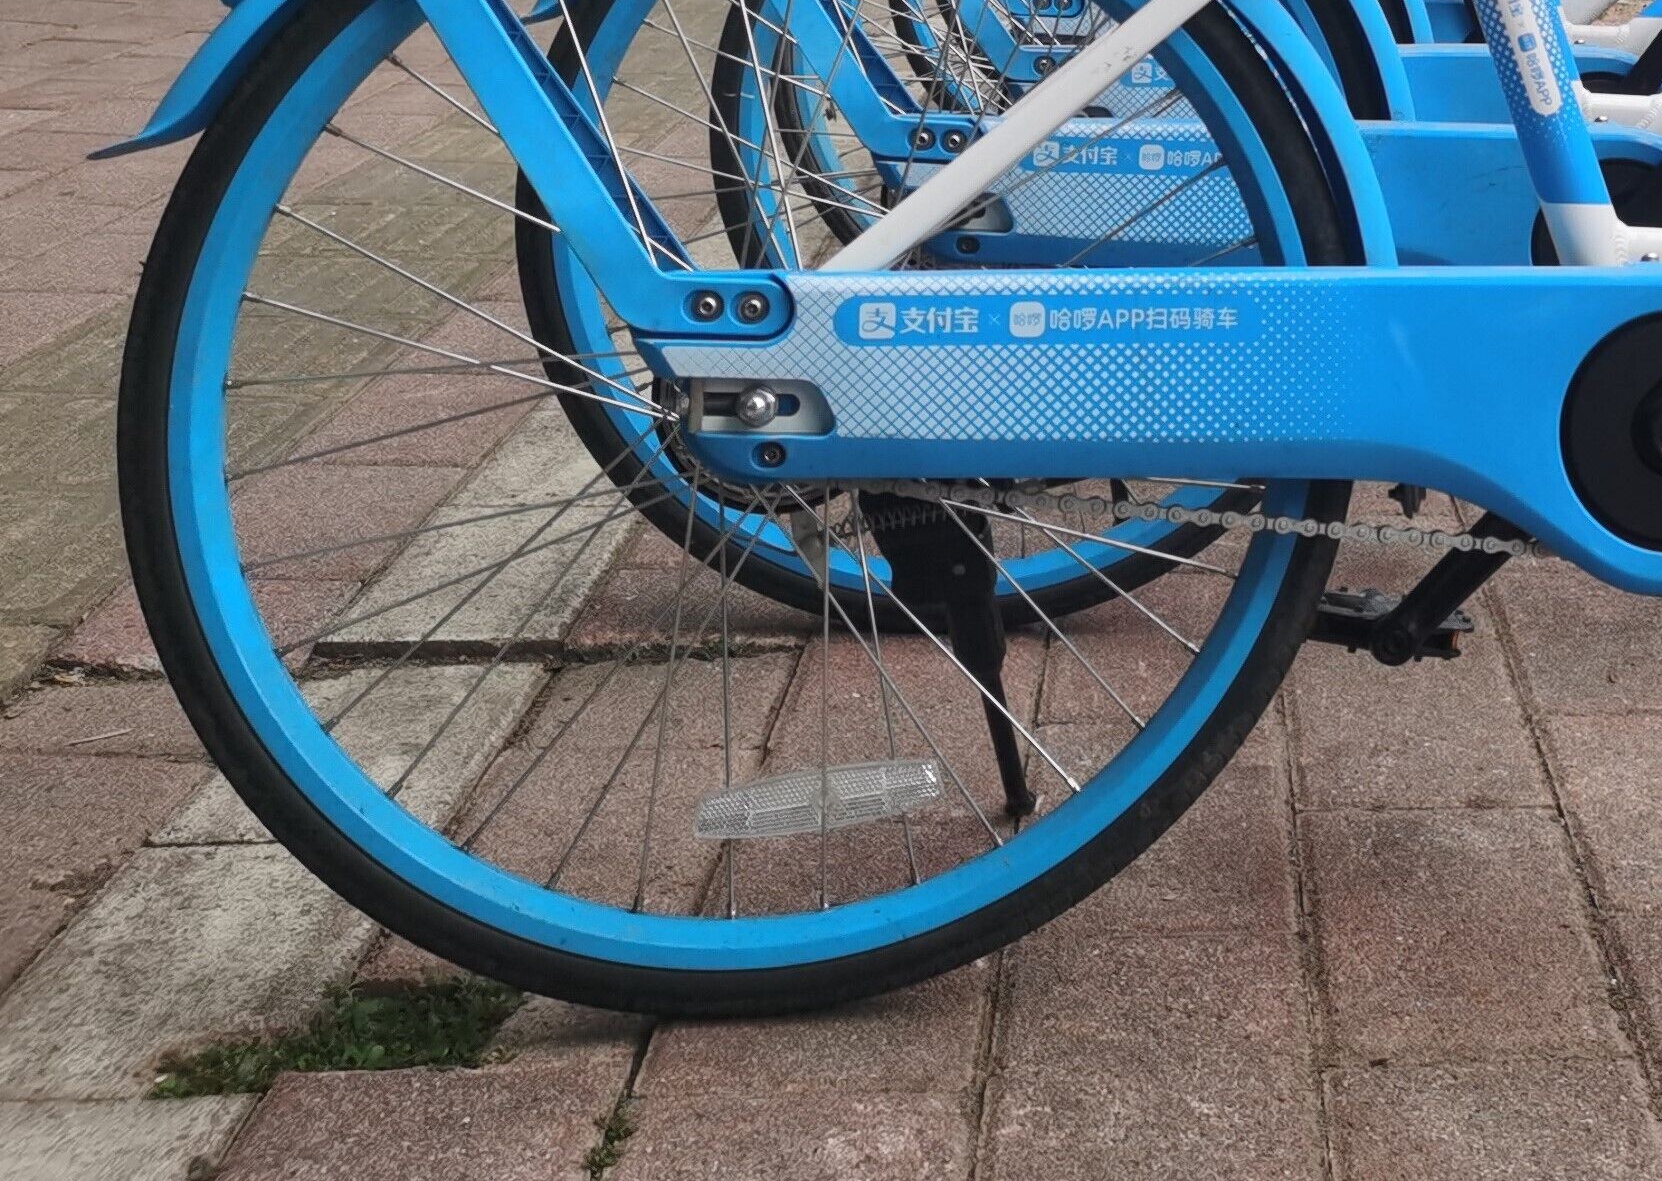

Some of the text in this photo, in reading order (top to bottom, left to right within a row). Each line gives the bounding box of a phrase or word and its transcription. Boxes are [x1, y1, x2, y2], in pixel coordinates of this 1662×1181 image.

[1062, 145, 1119, 166] 支付宝
[900, 306, 980, 334] 支付宝
